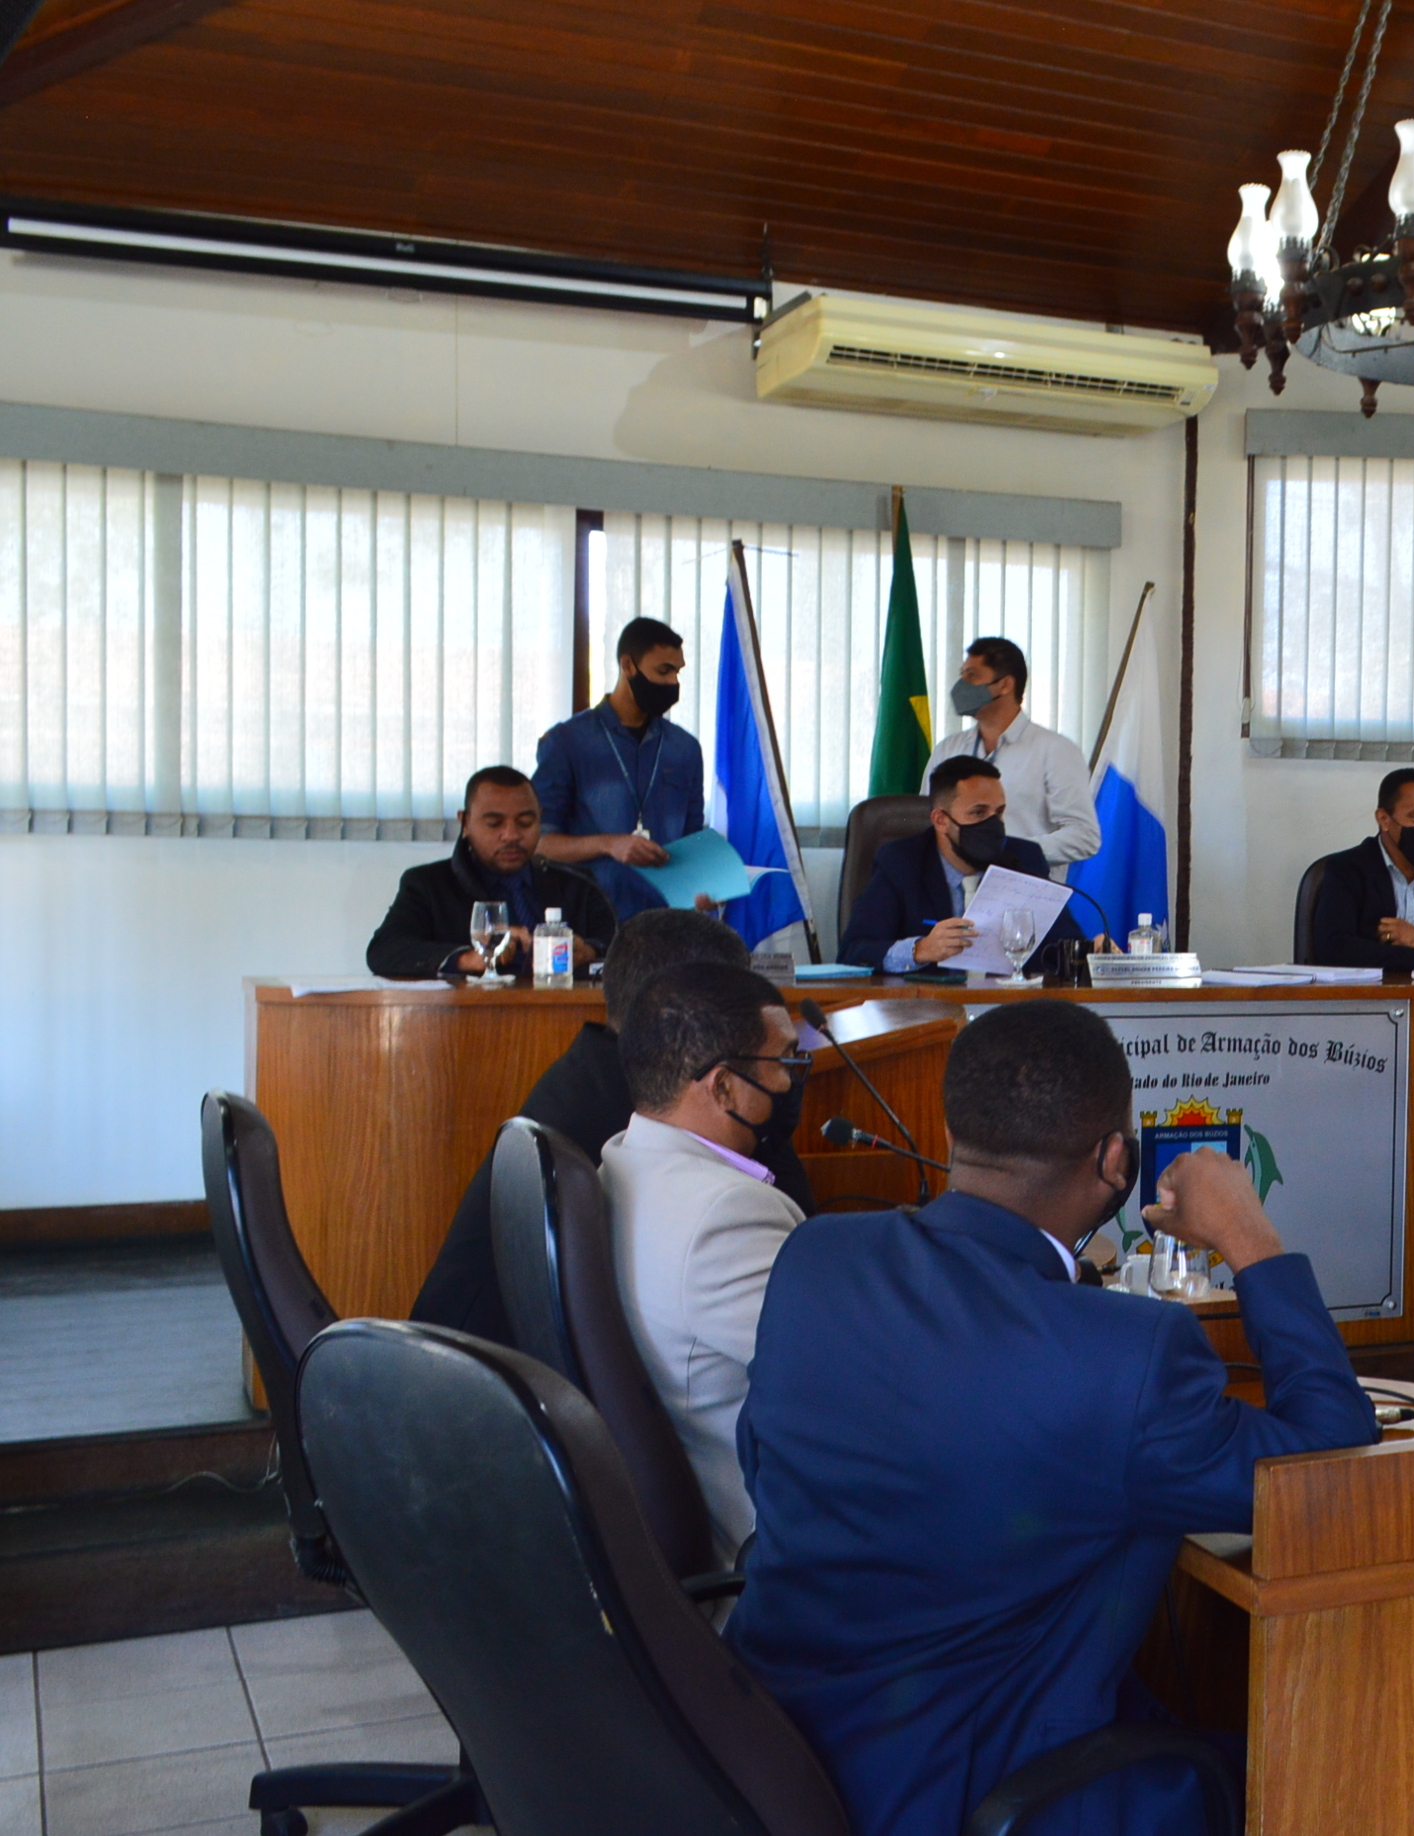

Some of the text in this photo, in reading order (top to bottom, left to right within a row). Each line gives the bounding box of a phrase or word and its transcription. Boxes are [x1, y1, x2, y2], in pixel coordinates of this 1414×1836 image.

[1177, 1033, 1196, 1053] de
[1201, 1031, 1281, 1061] Armação
[1288, 1037, 1319, 1058] dos
[1324, 1040, 1388, 1073] Búzios
[1131, 1074, 1158, 1089] ado
[1162, 1073, 1178, 1089] do
[1222, 1071, 1270, 1088] Janeiro
[1155, 1131, 1188, 1140] ARMAÇÃO
[1205, 1130, 1229, 1138] BÚZIOS
